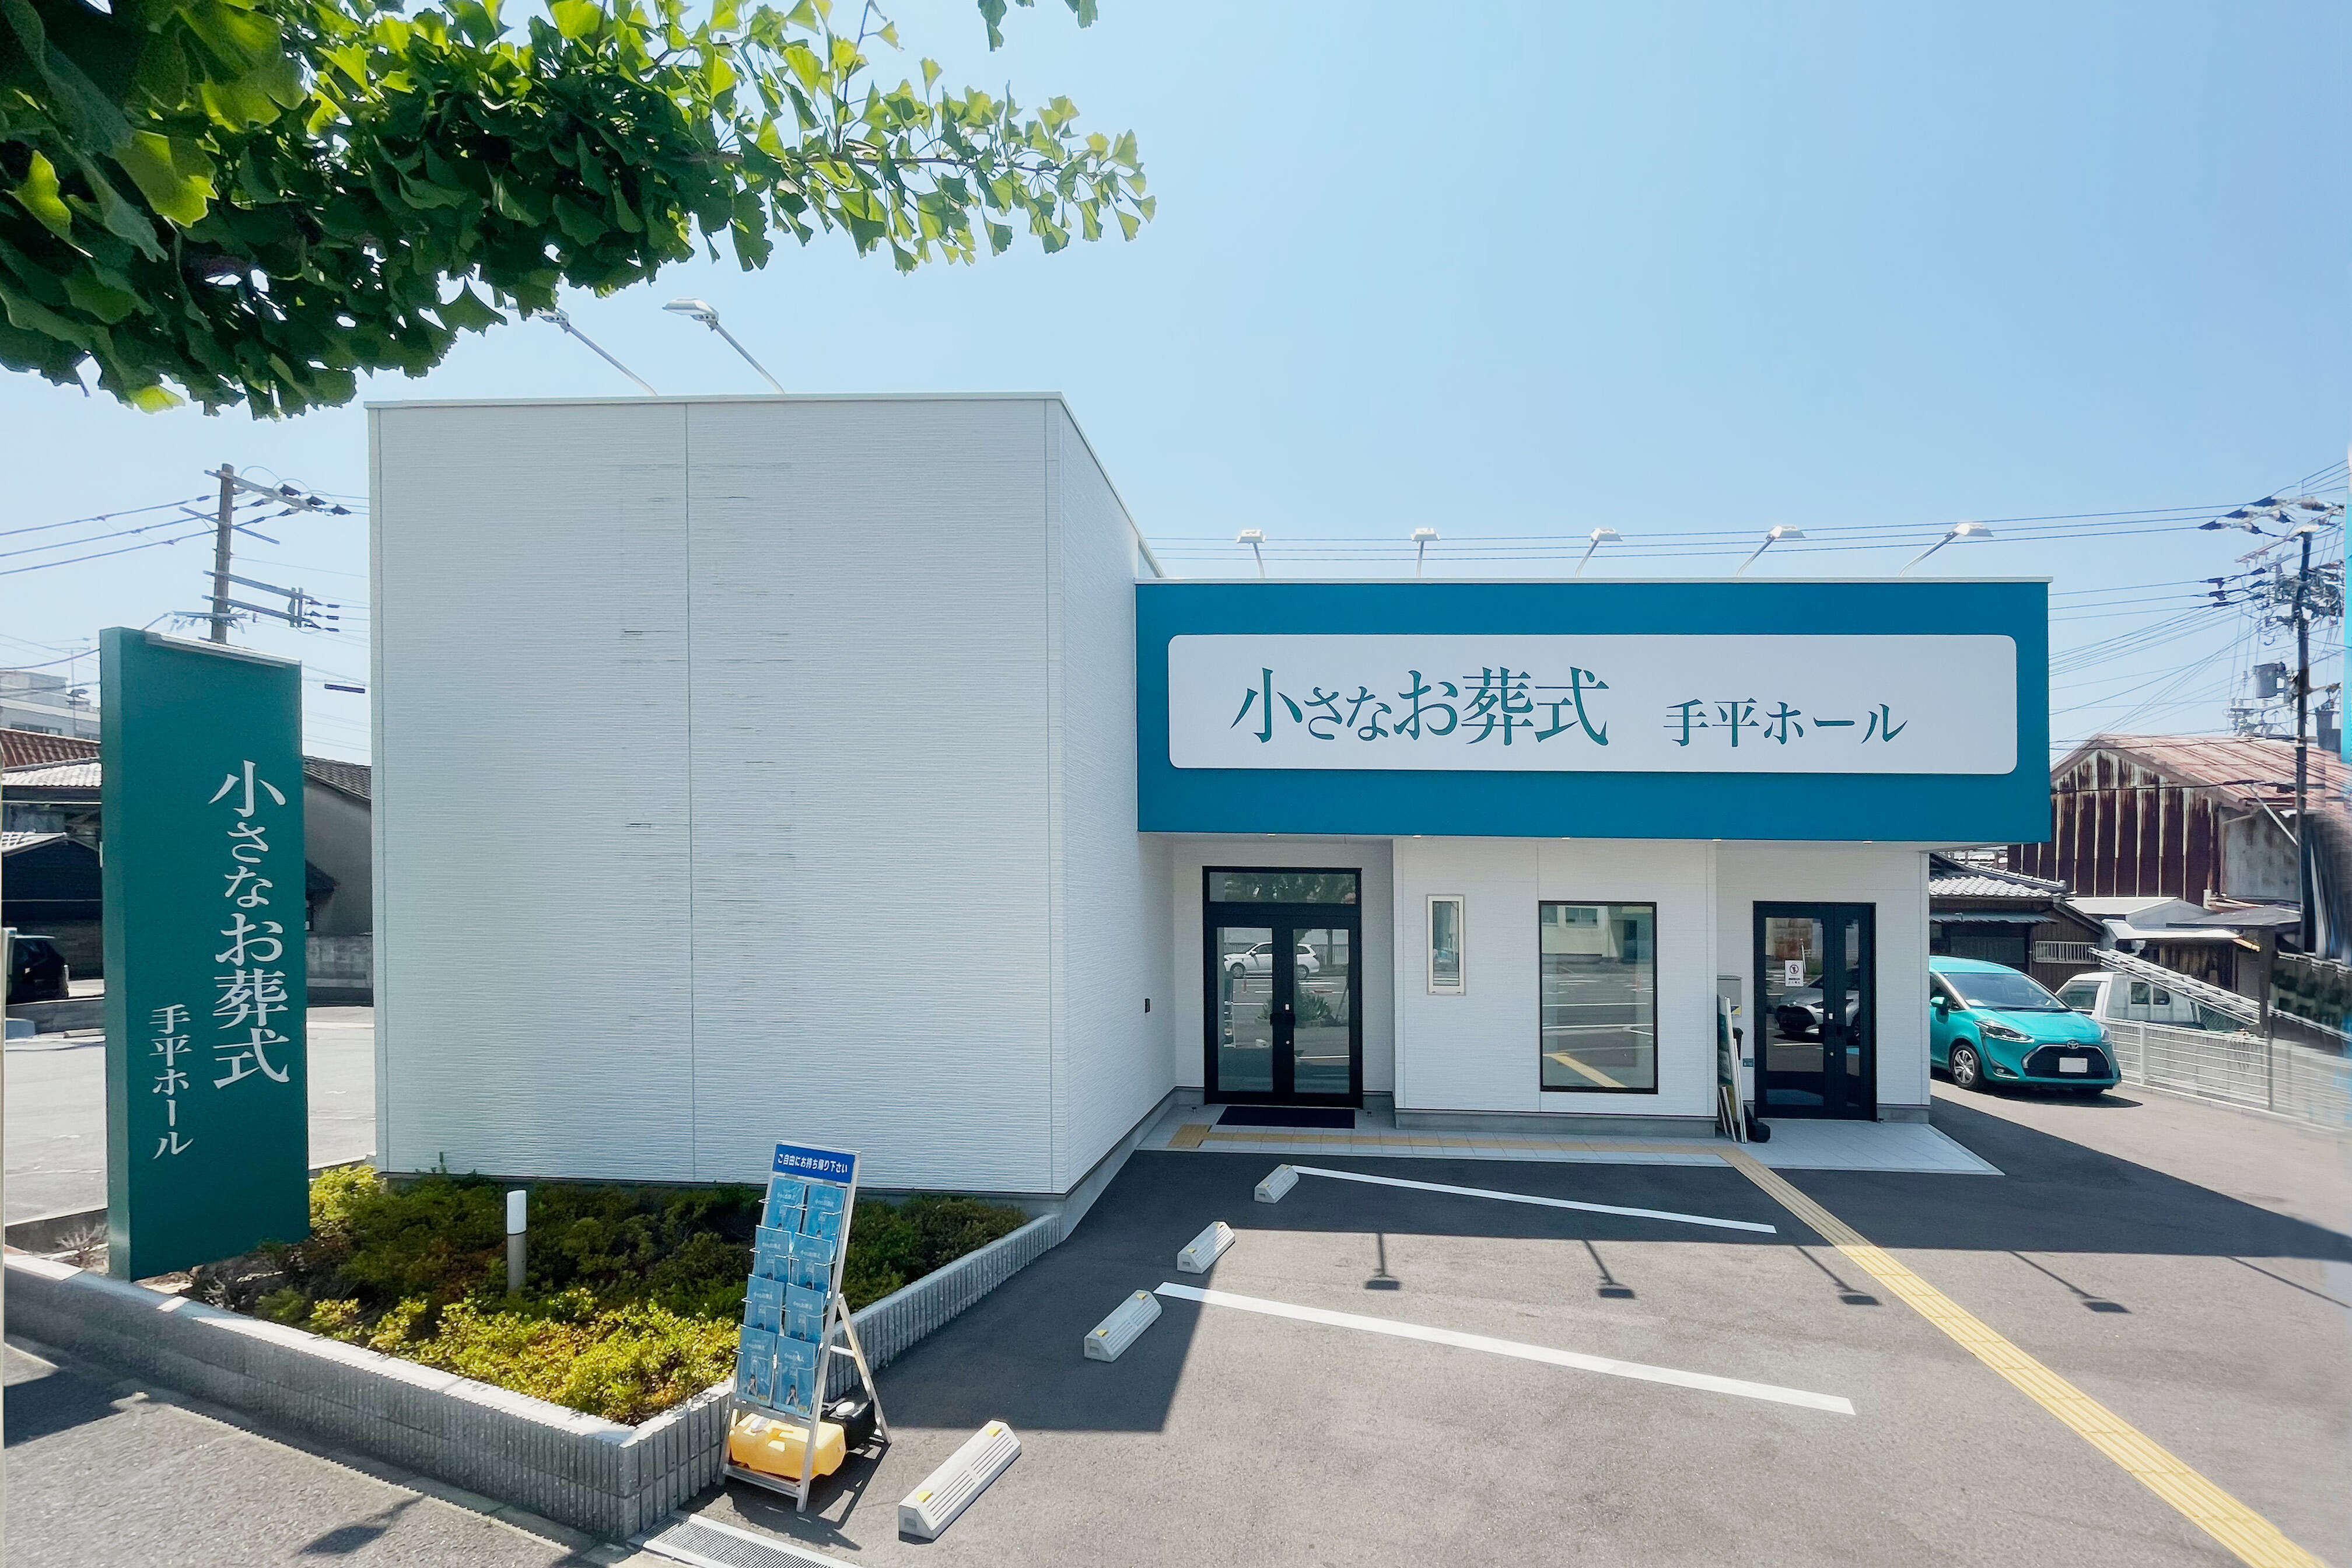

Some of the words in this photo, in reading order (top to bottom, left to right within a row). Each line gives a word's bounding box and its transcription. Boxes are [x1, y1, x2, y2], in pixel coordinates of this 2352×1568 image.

[1230, 666, 1609, 747] 小さなお葬式
[1663, 697, 1908, 748] 手平ホール
[209, 760, 290, 1089] 小さなお葬式
[149, 1003, 194, 1159] 手平ホール
[778, 1153, 848, 1173] ご自由にお持ち帰り下さい
